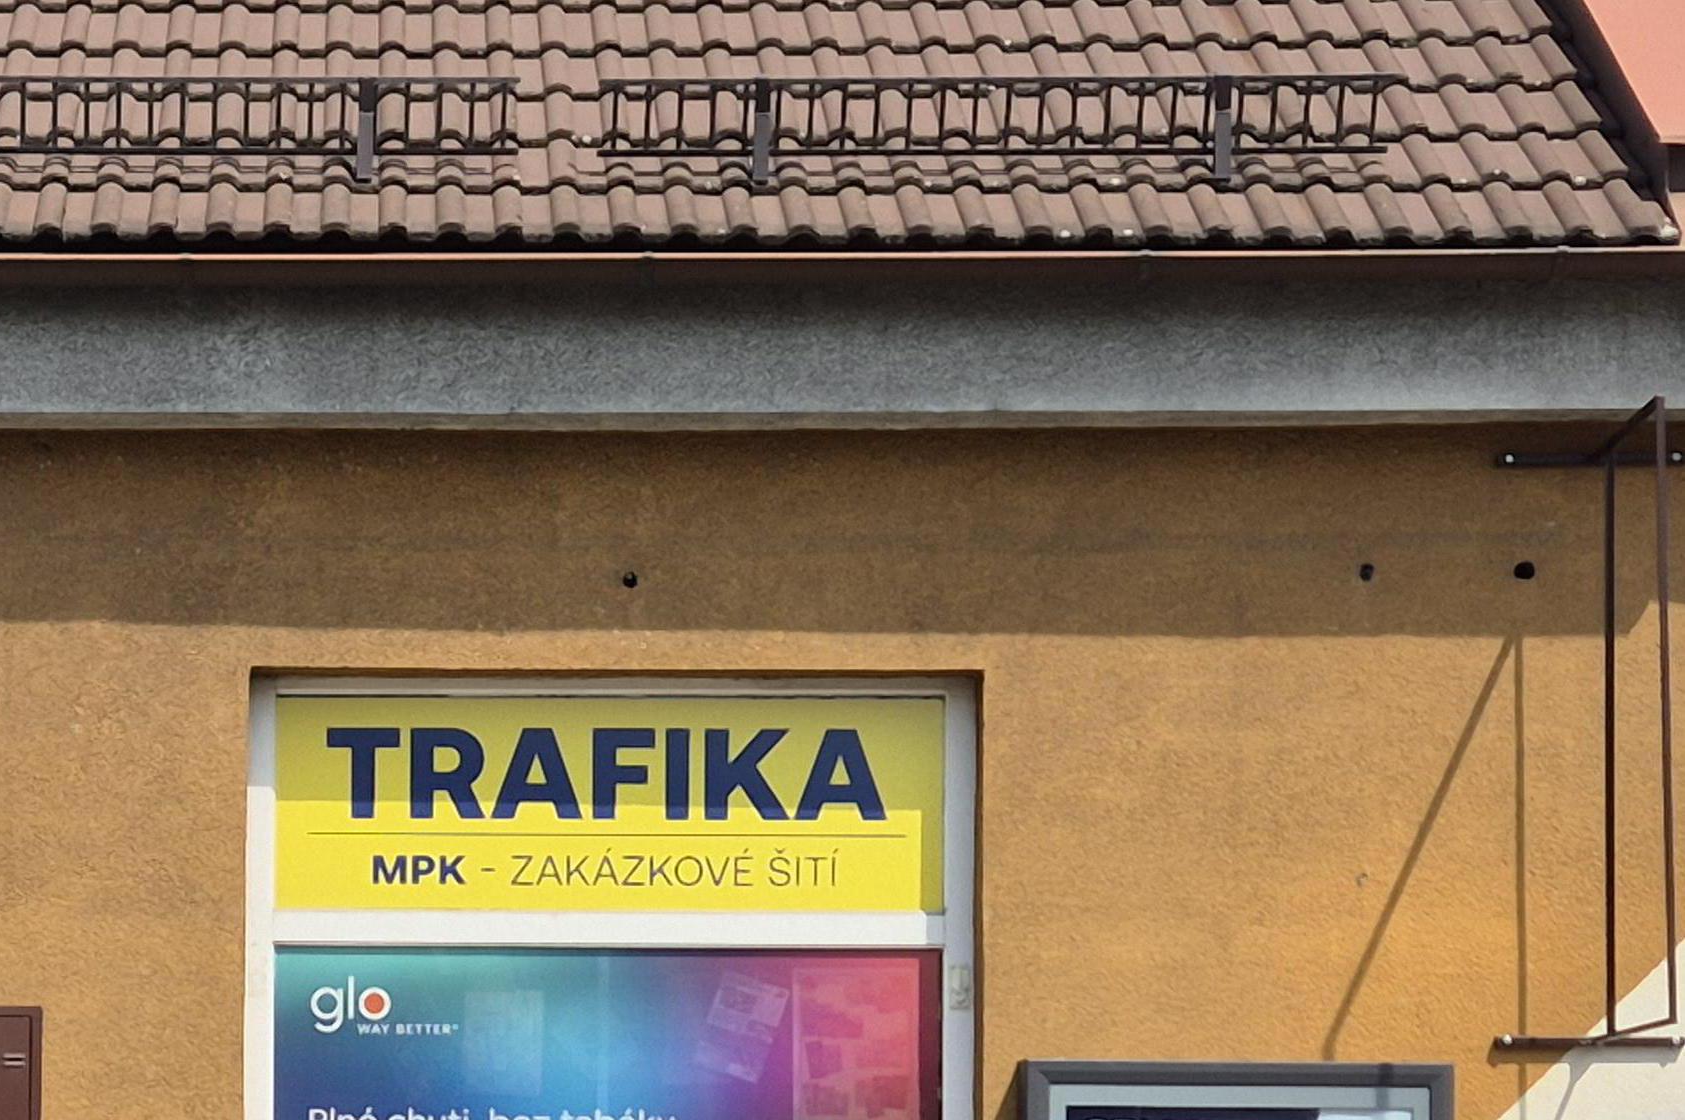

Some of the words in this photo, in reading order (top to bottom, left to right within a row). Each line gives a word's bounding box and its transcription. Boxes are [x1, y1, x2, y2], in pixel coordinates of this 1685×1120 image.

[326, 727, 888, 821] TRAFIKA
[371, 855, 467, 886] MPK
[511, 848, 755, 887] ZAKÁZKOVÉ
[768, 848, 838, 888] ŠITÍ
[309, 975, 392, 1033] glo
[357, 1023, 390, 1036] WAY
